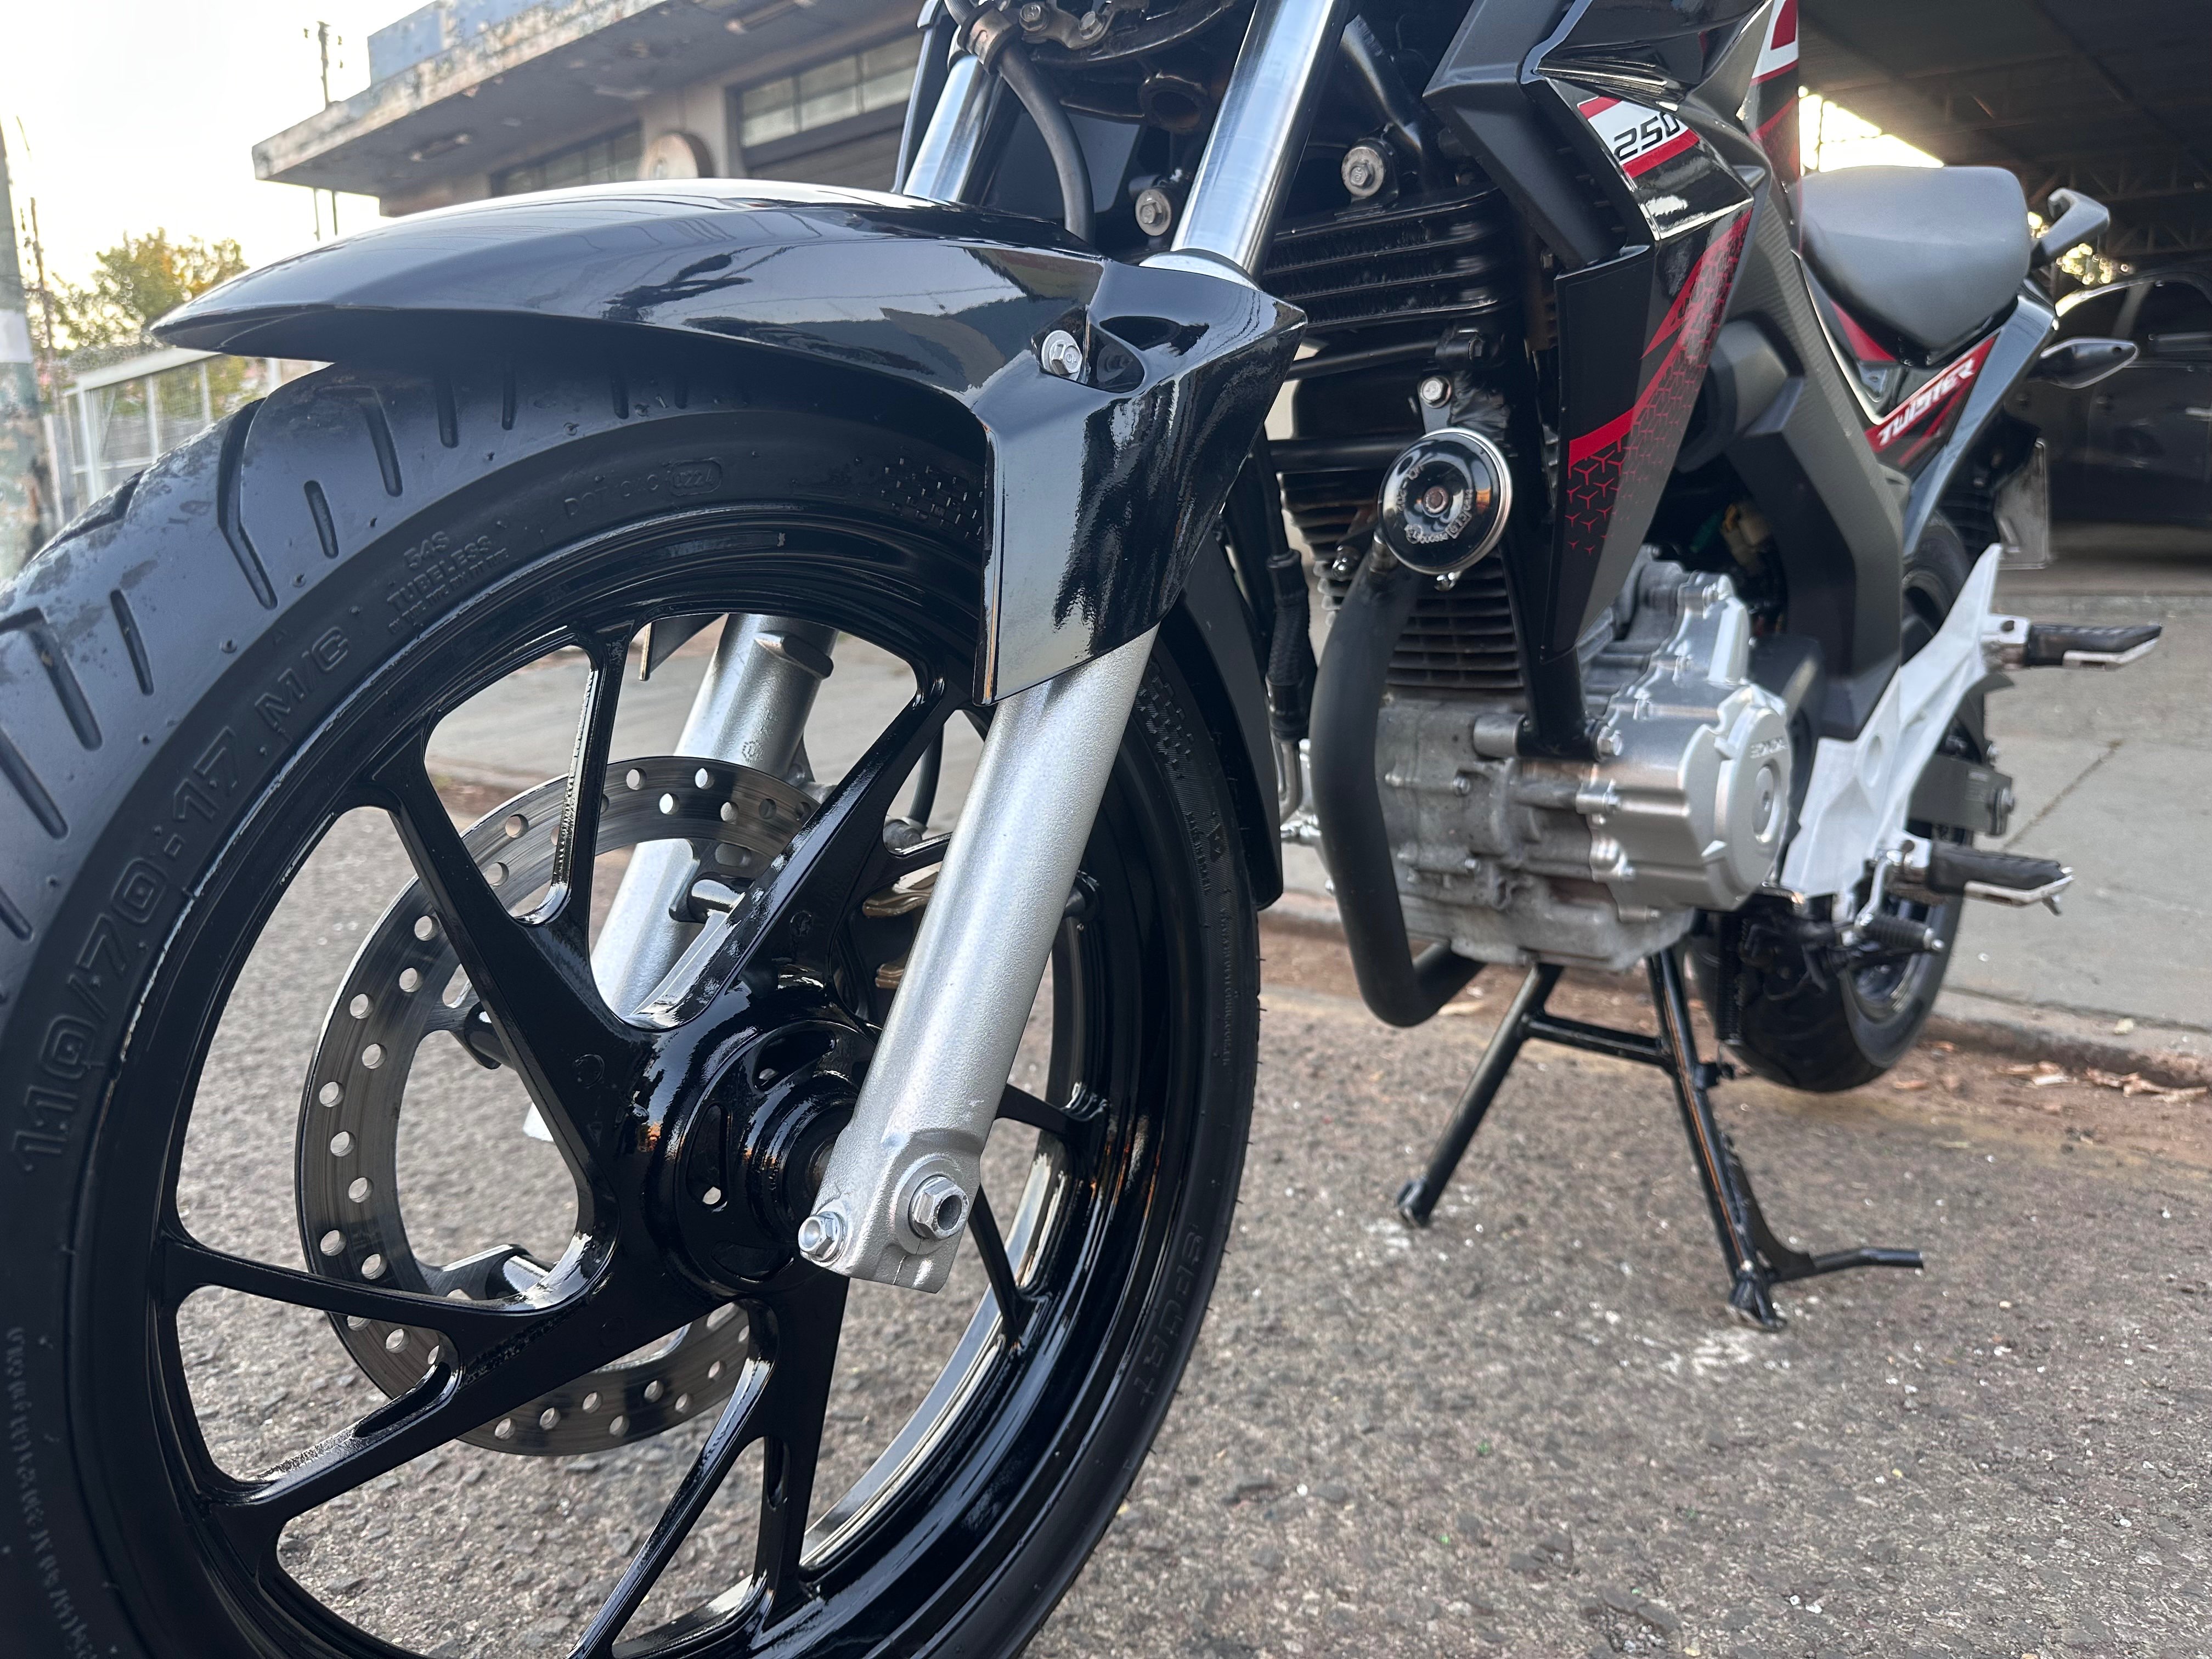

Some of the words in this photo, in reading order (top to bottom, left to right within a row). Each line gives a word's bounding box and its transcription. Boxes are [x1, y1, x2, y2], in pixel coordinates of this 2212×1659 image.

[1614, 110, 1680, 161] 250
[1876, 358, 1974, 447] TWISTER
[386, 535, 492, 606] TUBELESS
[254, 626, 349, 733] M/C
